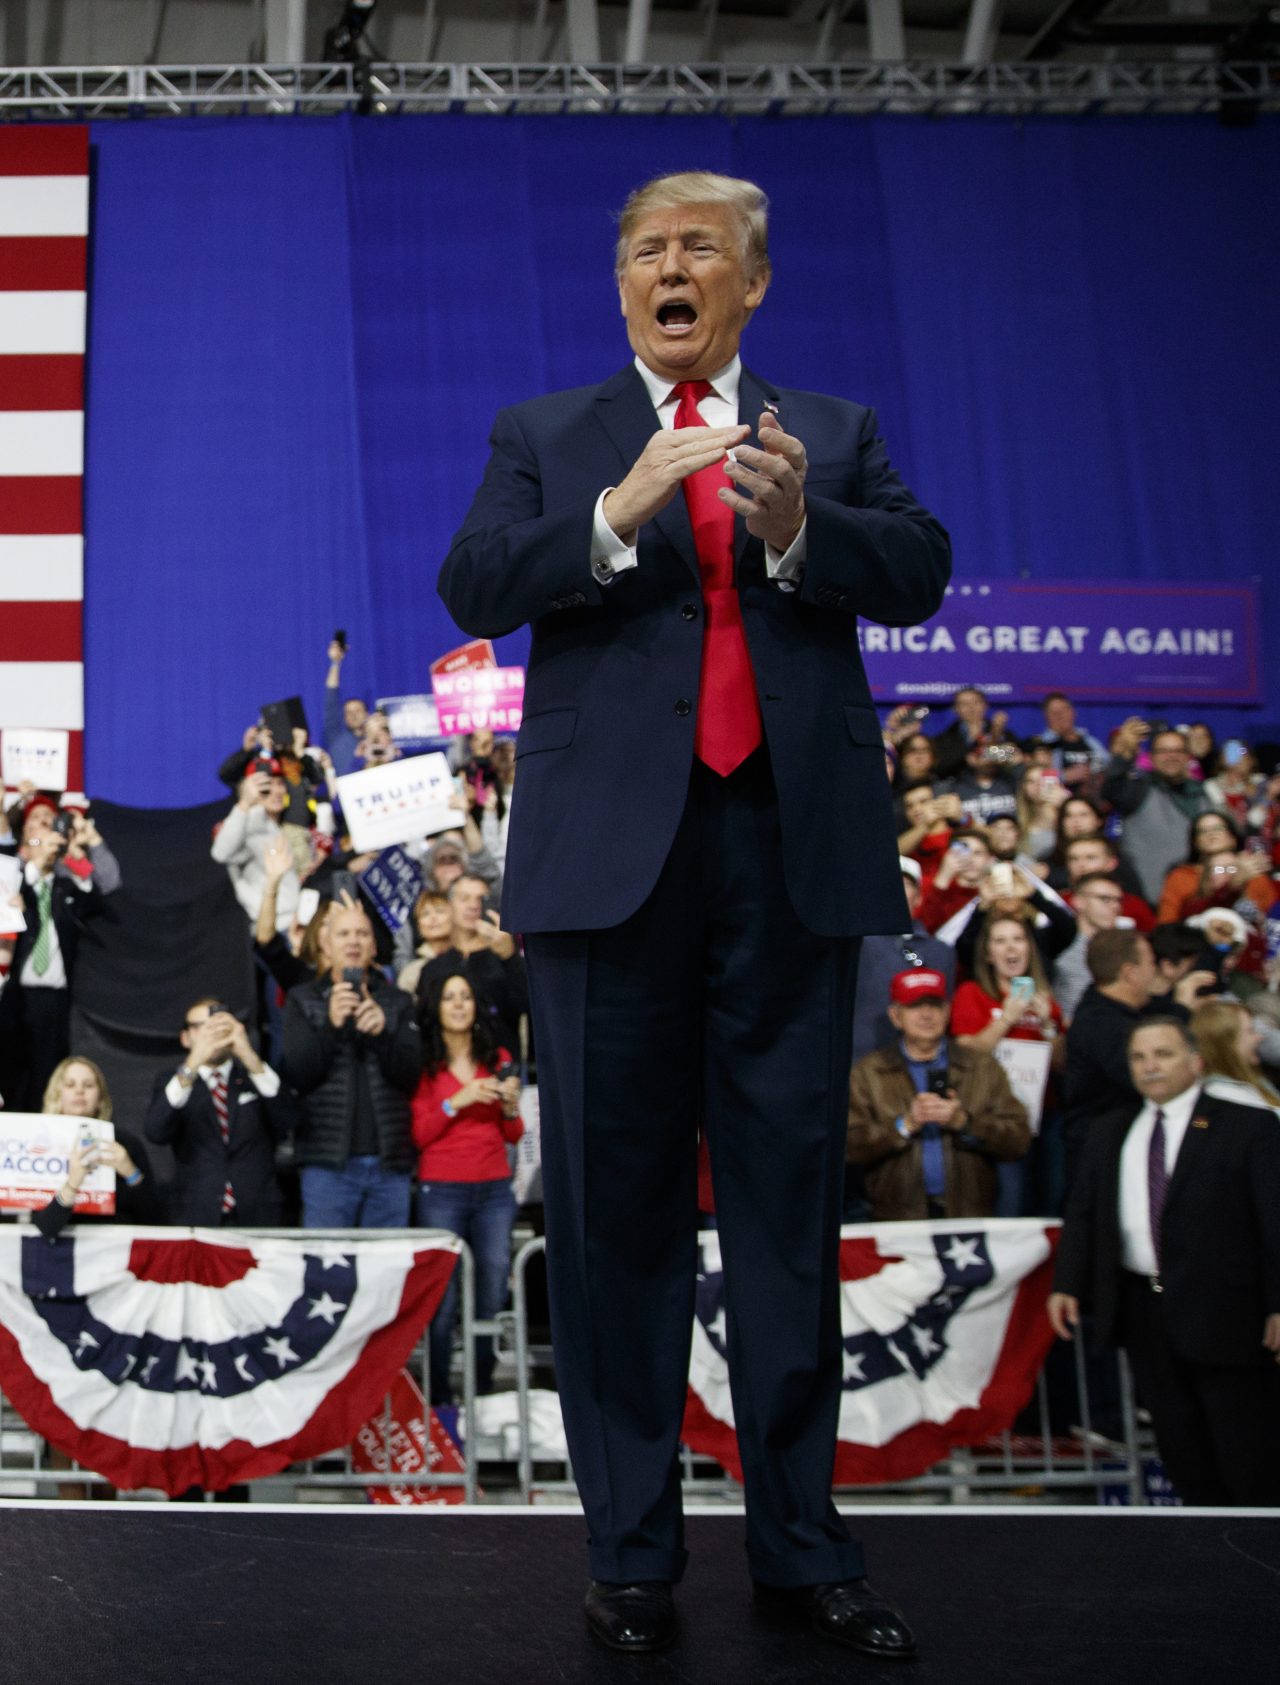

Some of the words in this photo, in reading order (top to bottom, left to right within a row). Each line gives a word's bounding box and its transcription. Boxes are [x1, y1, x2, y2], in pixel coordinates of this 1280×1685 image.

[966, 625, 1089, 653] GREAT
[1099, 626, 1235, 656] AGAIN!
[434, 671, 524, 696] WOMEN
[441, 708, 521, 731] TRUMP
[355, 777, 440, 808] TRUMP
